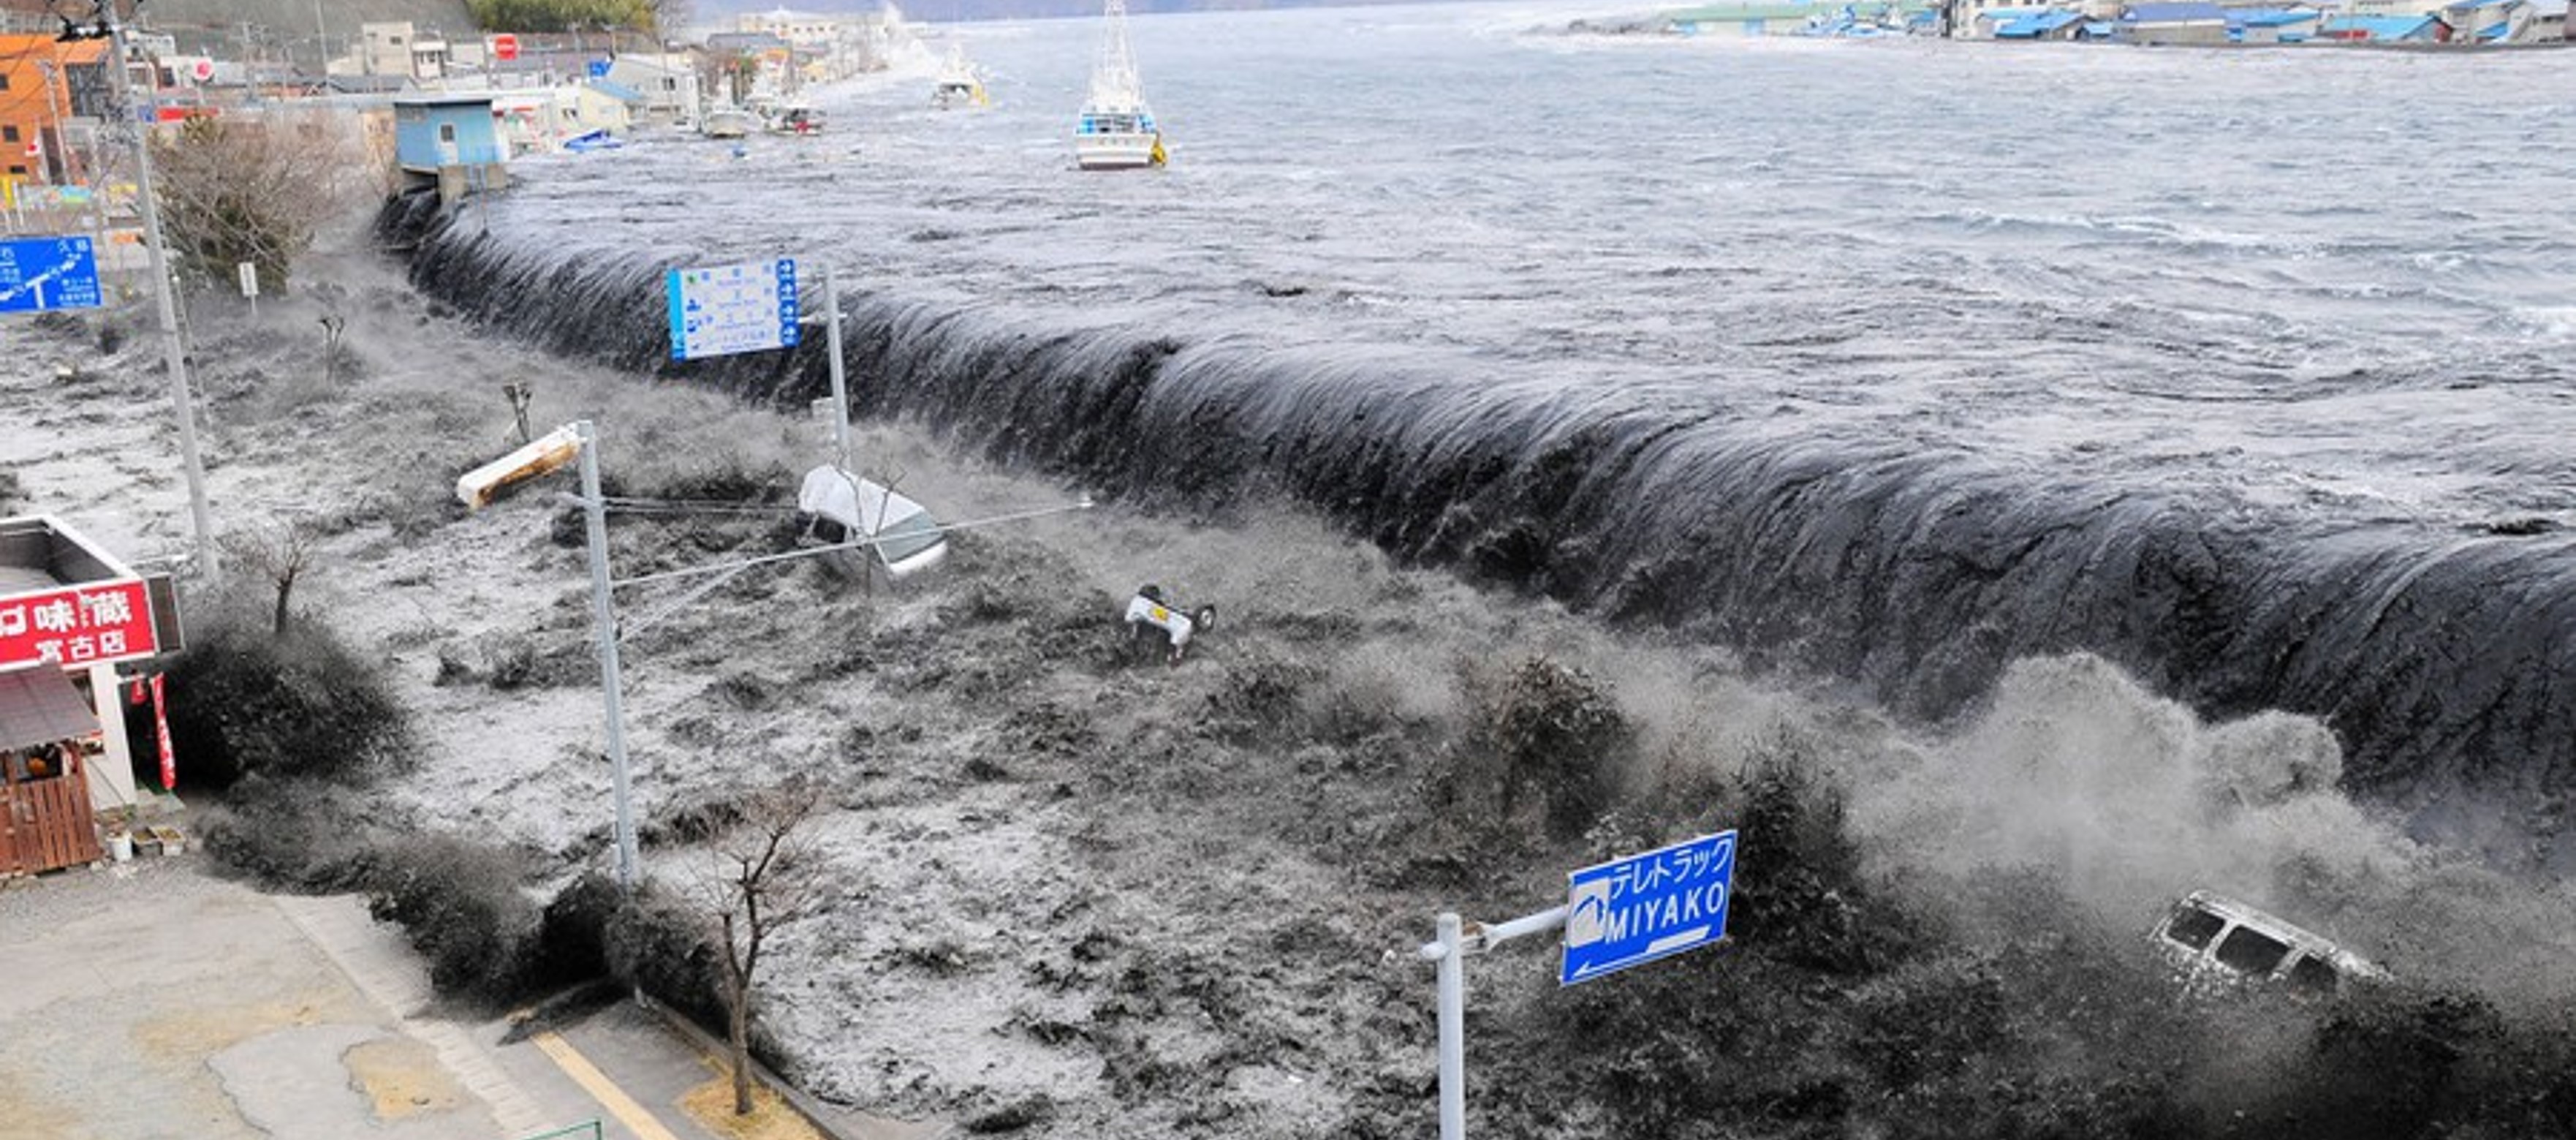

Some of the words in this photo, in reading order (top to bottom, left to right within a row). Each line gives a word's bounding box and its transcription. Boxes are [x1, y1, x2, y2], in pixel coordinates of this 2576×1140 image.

[37, 629, 127, 662] 宮古店
[1611, 838, 1733, 900] テレトラック
[1605, 880, 1724, 945] MIYAKO
